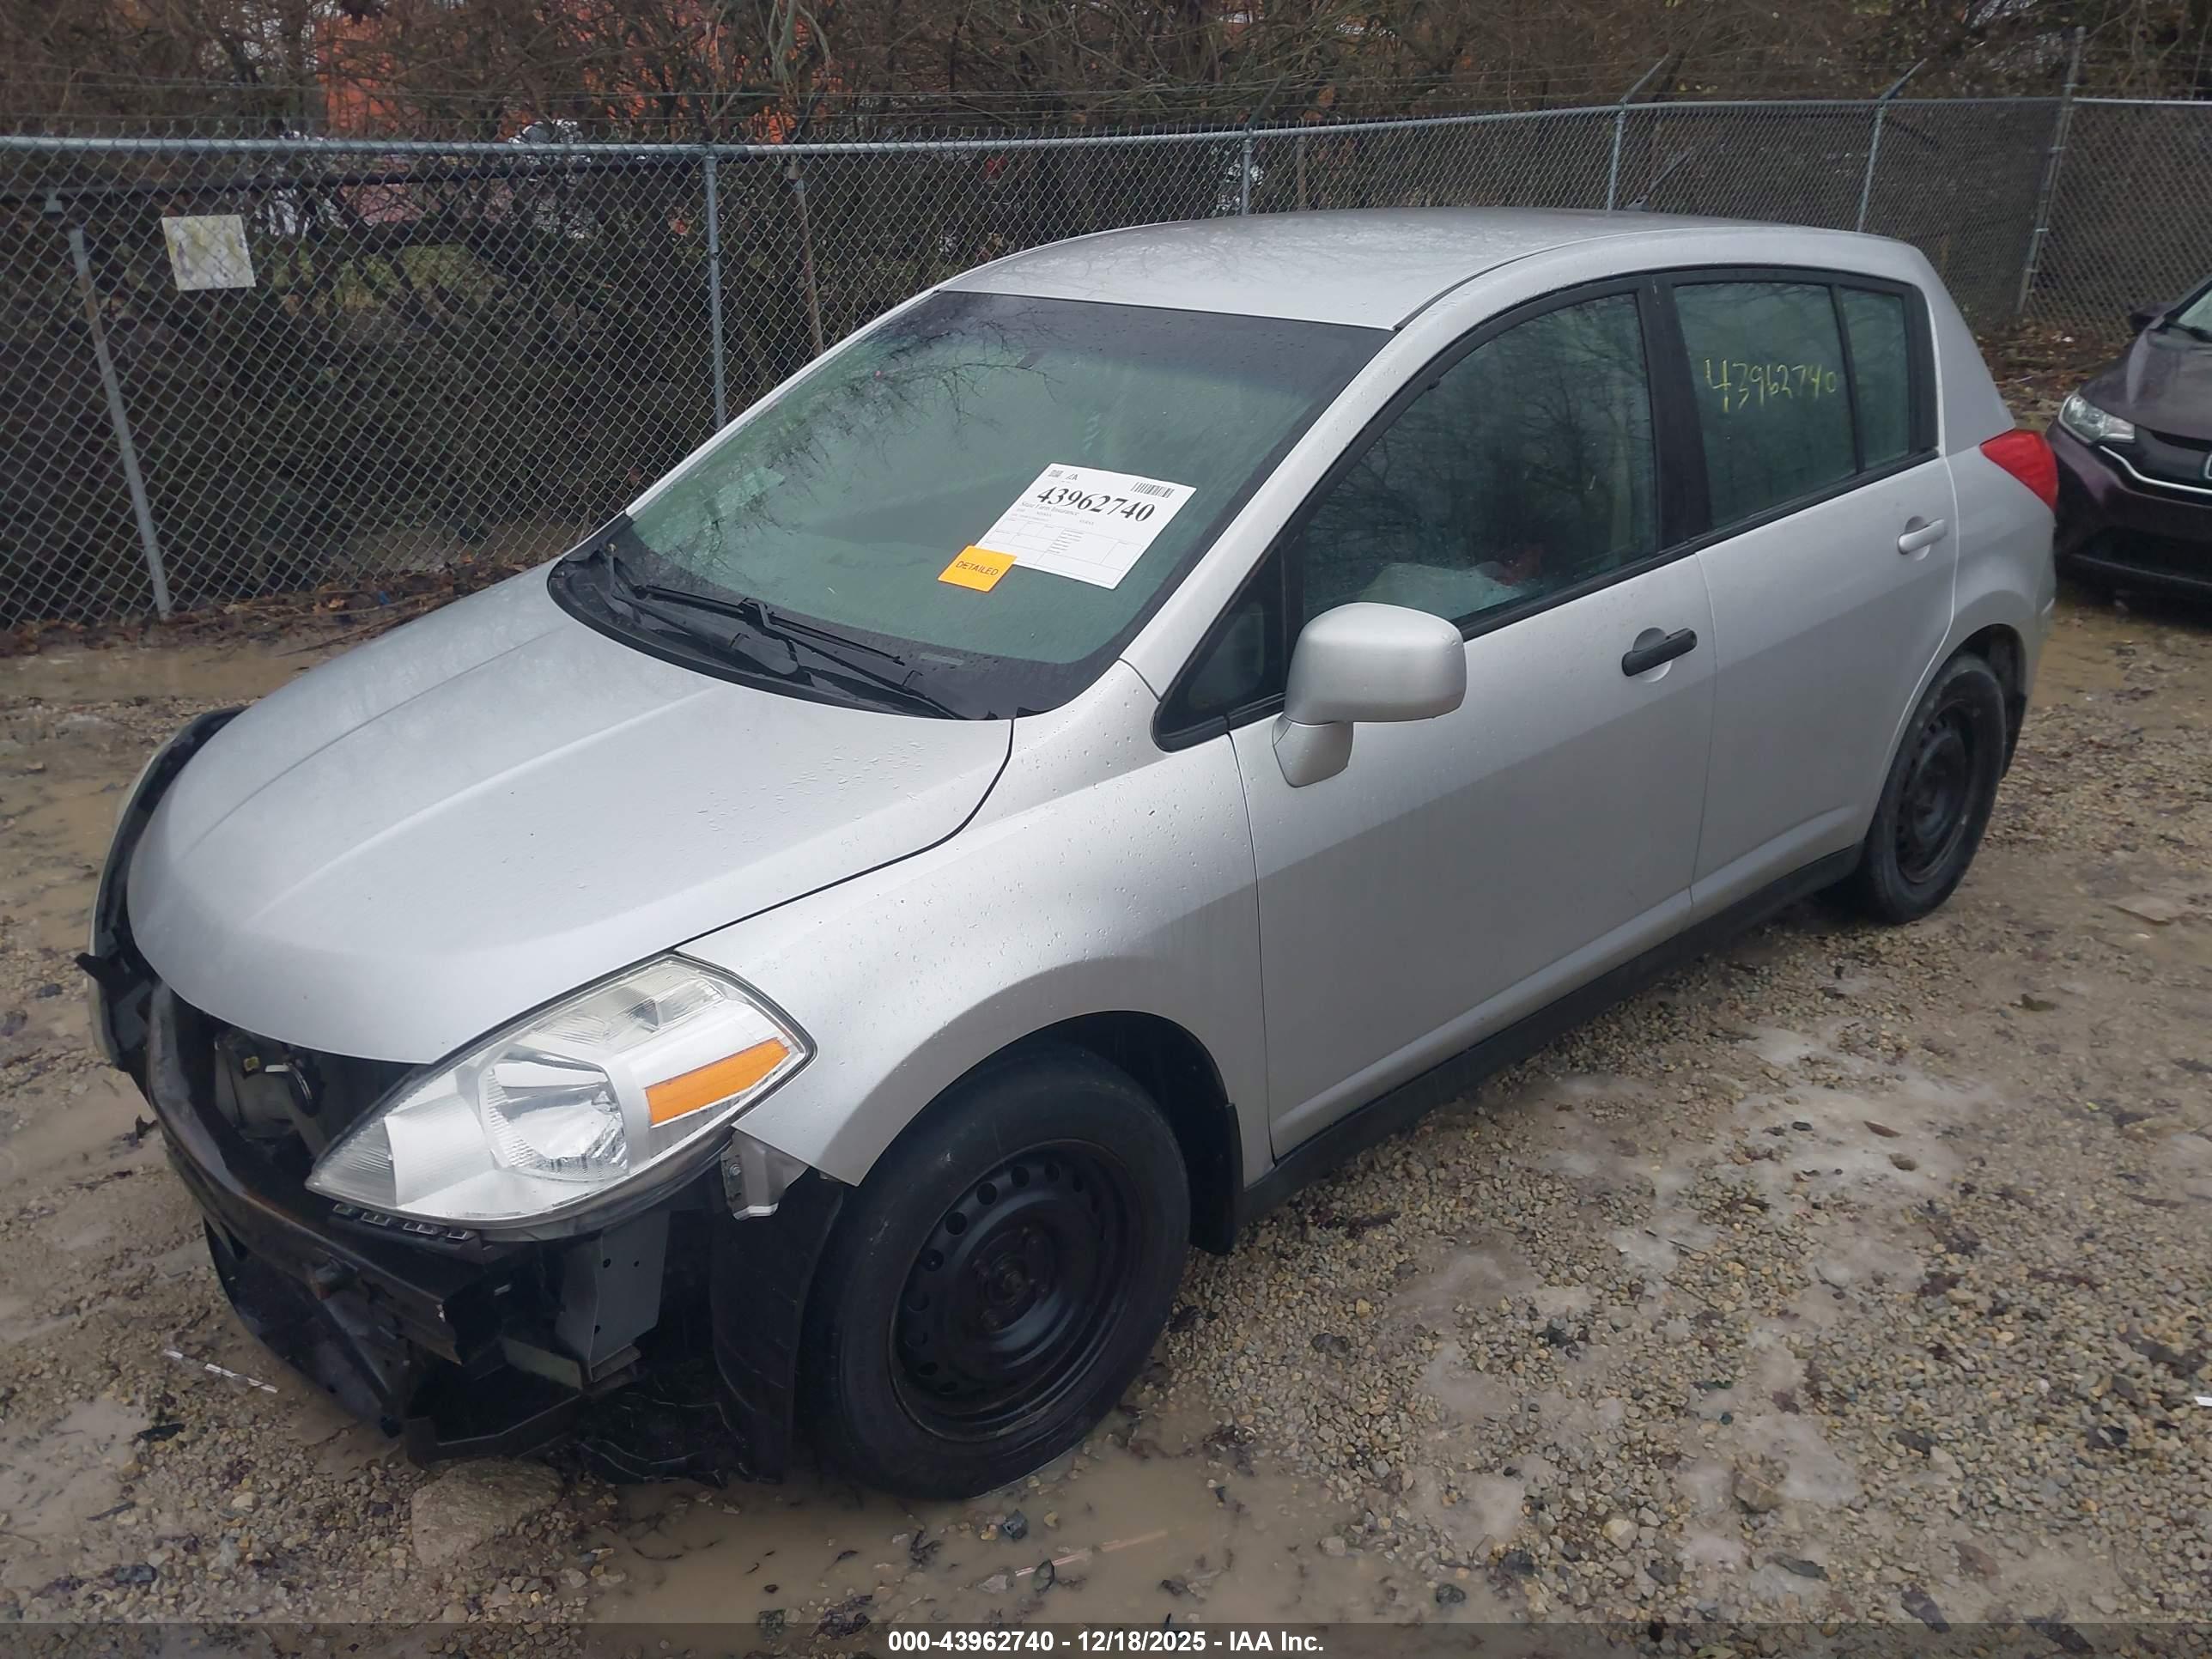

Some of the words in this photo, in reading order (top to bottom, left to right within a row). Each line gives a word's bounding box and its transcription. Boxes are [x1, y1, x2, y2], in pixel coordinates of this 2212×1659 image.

[1704, 357, 1838, 413] 43962740
[1036, 486, 1155, 522] 43962740
[955, 560, 999, 577] DETAILED
